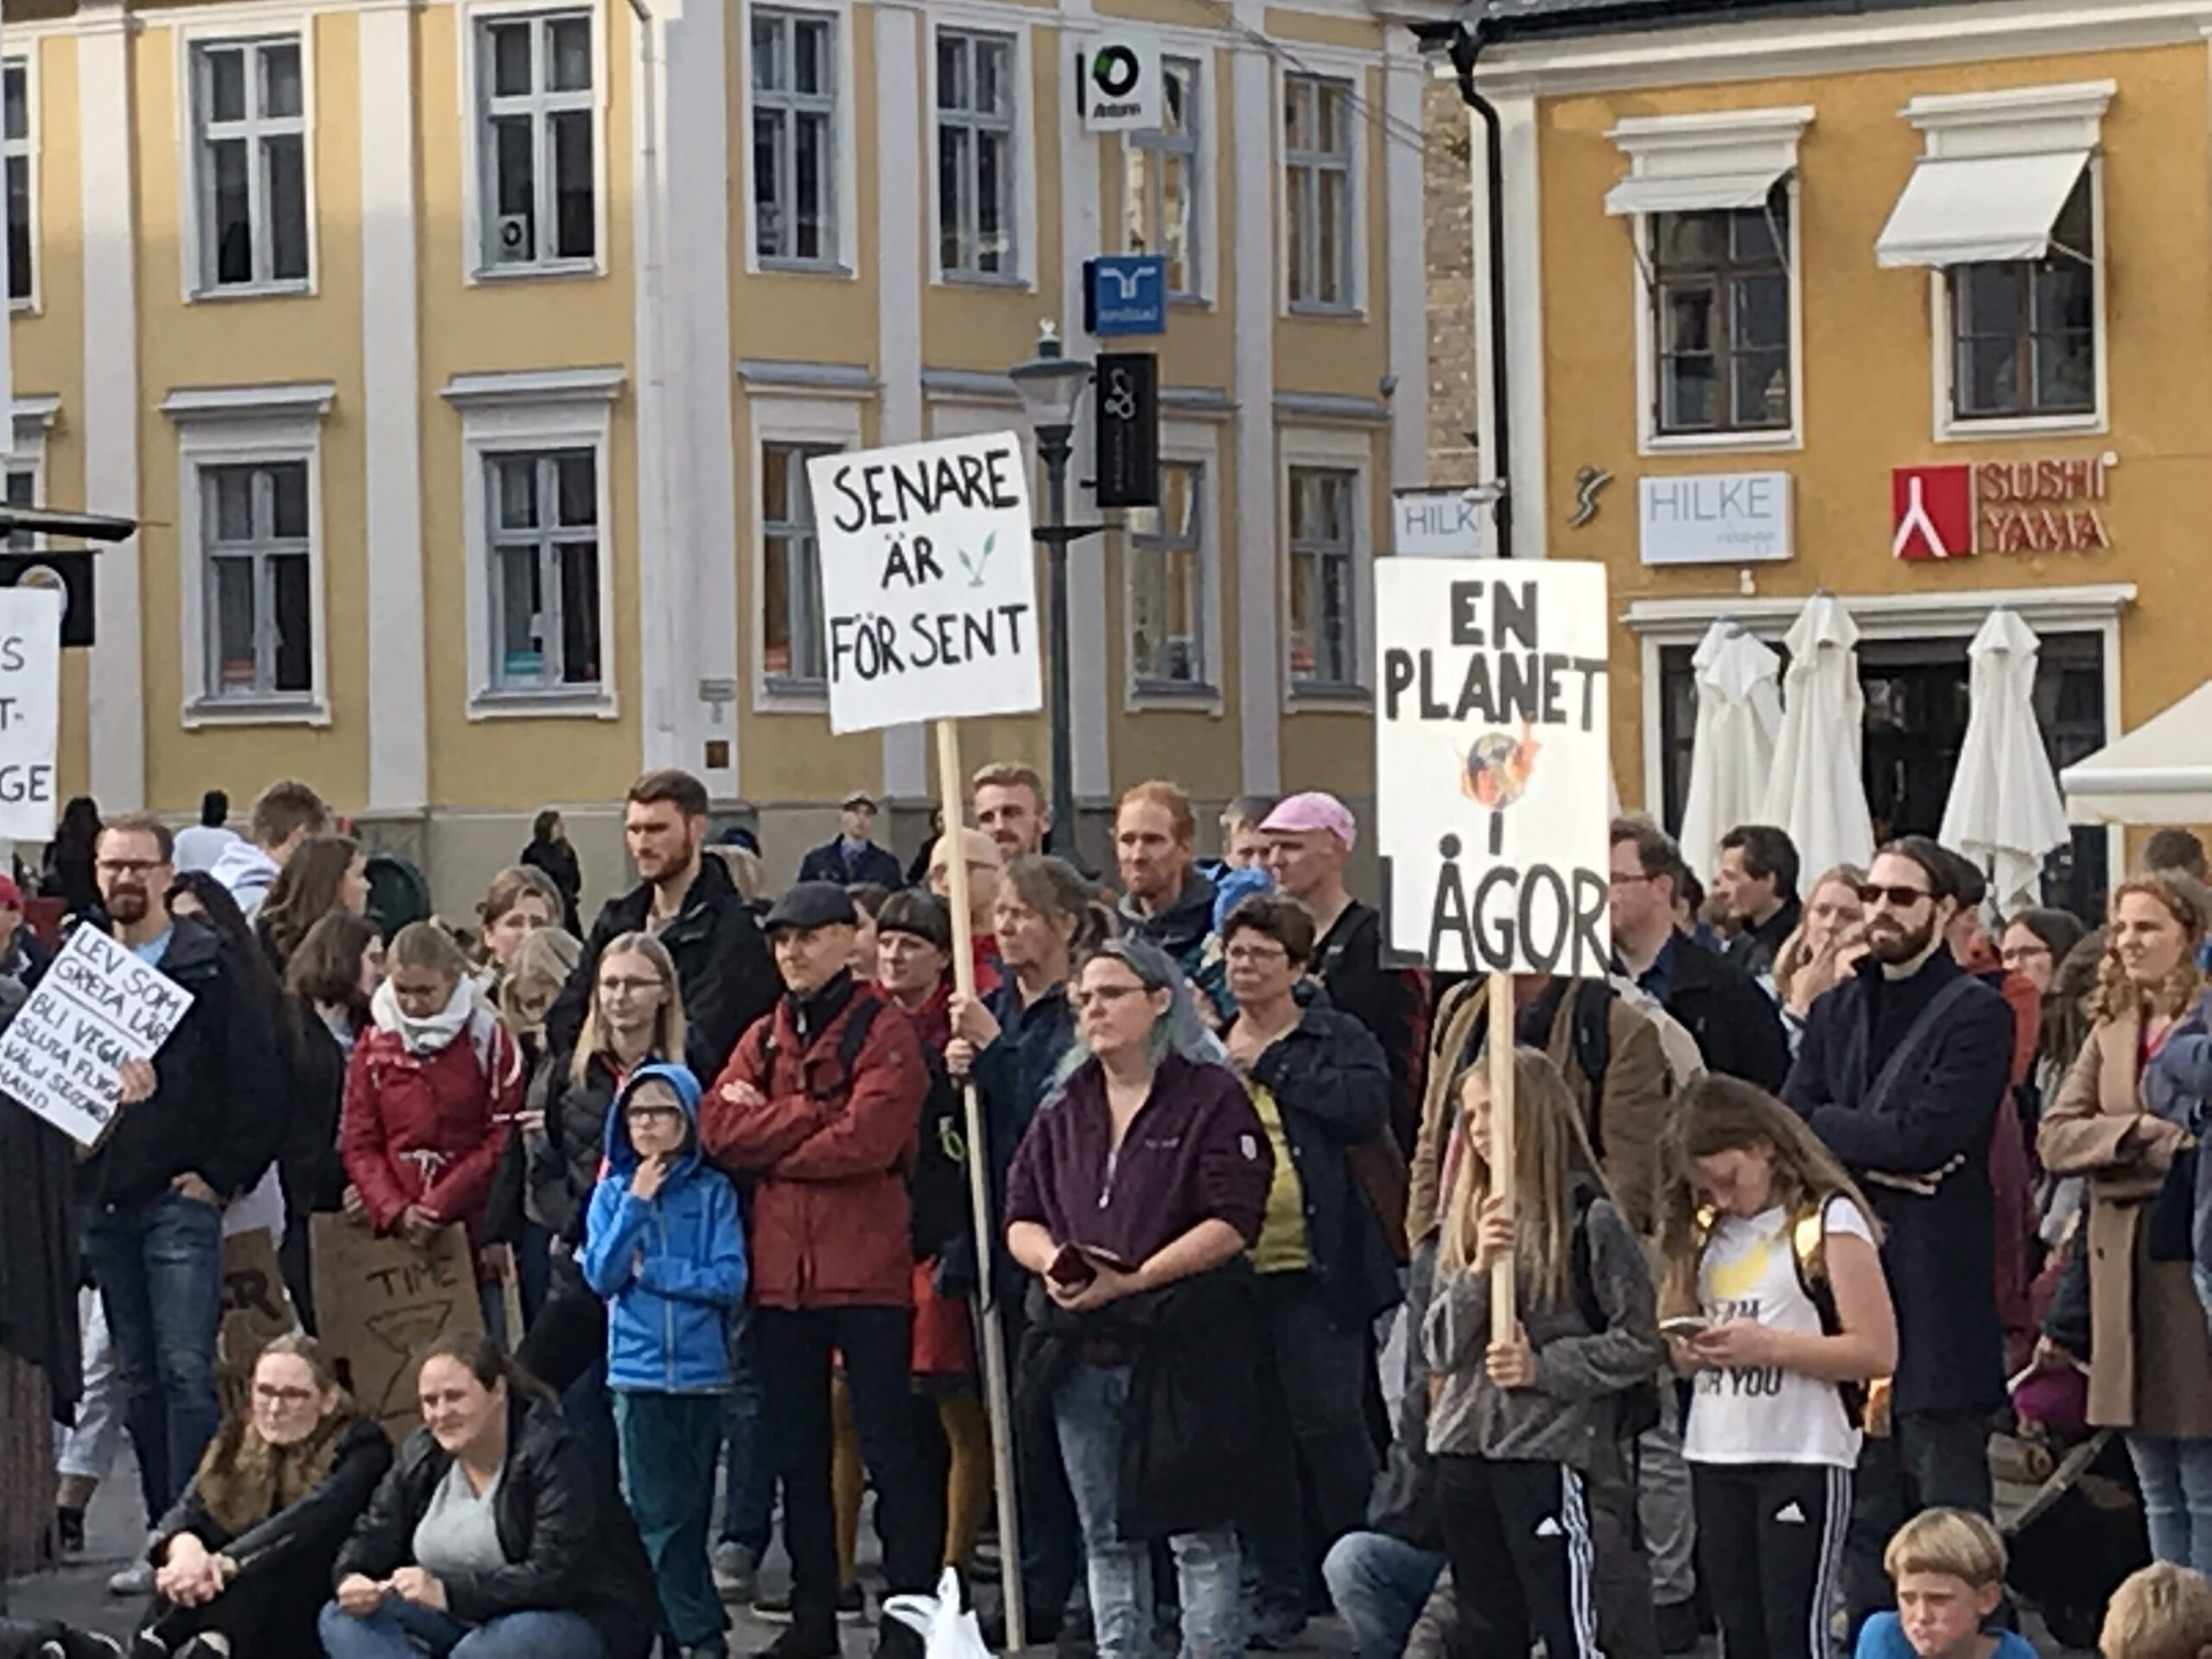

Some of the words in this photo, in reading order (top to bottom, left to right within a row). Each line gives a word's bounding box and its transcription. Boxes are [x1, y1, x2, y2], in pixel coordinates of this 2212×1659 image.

[833, 448, 1020, 533] SENARE
[1649, 478, 1771, 522] HILKE
[1978, 459, 2106, 499] SUSHI
[1986, 508, 2111, 552] YAMA
[880, 531, 944, 589] ÄR
[1451, 580, 1538, 650] EN
[830, 610, 906, 683] FÖR
[910, 603, 1029, 668] SENT
[1384, 648, 1609, 733] PLANET
[1379, 834, 1611, 974] LÅGOR
[54, 956, 126, 1017] GRETA
[74, 930, 126, 976] LEV
[122, 968, 183, 1021] SOM
[31, 993, 69, 1029] BLI
[15, 1017, 71, 1066] SLUTA
[47, 1073, 110, 1123] SECOND
[365, 1255, 458, 1297] TIME
[1729, 1365, 1783, 1396] YOU
